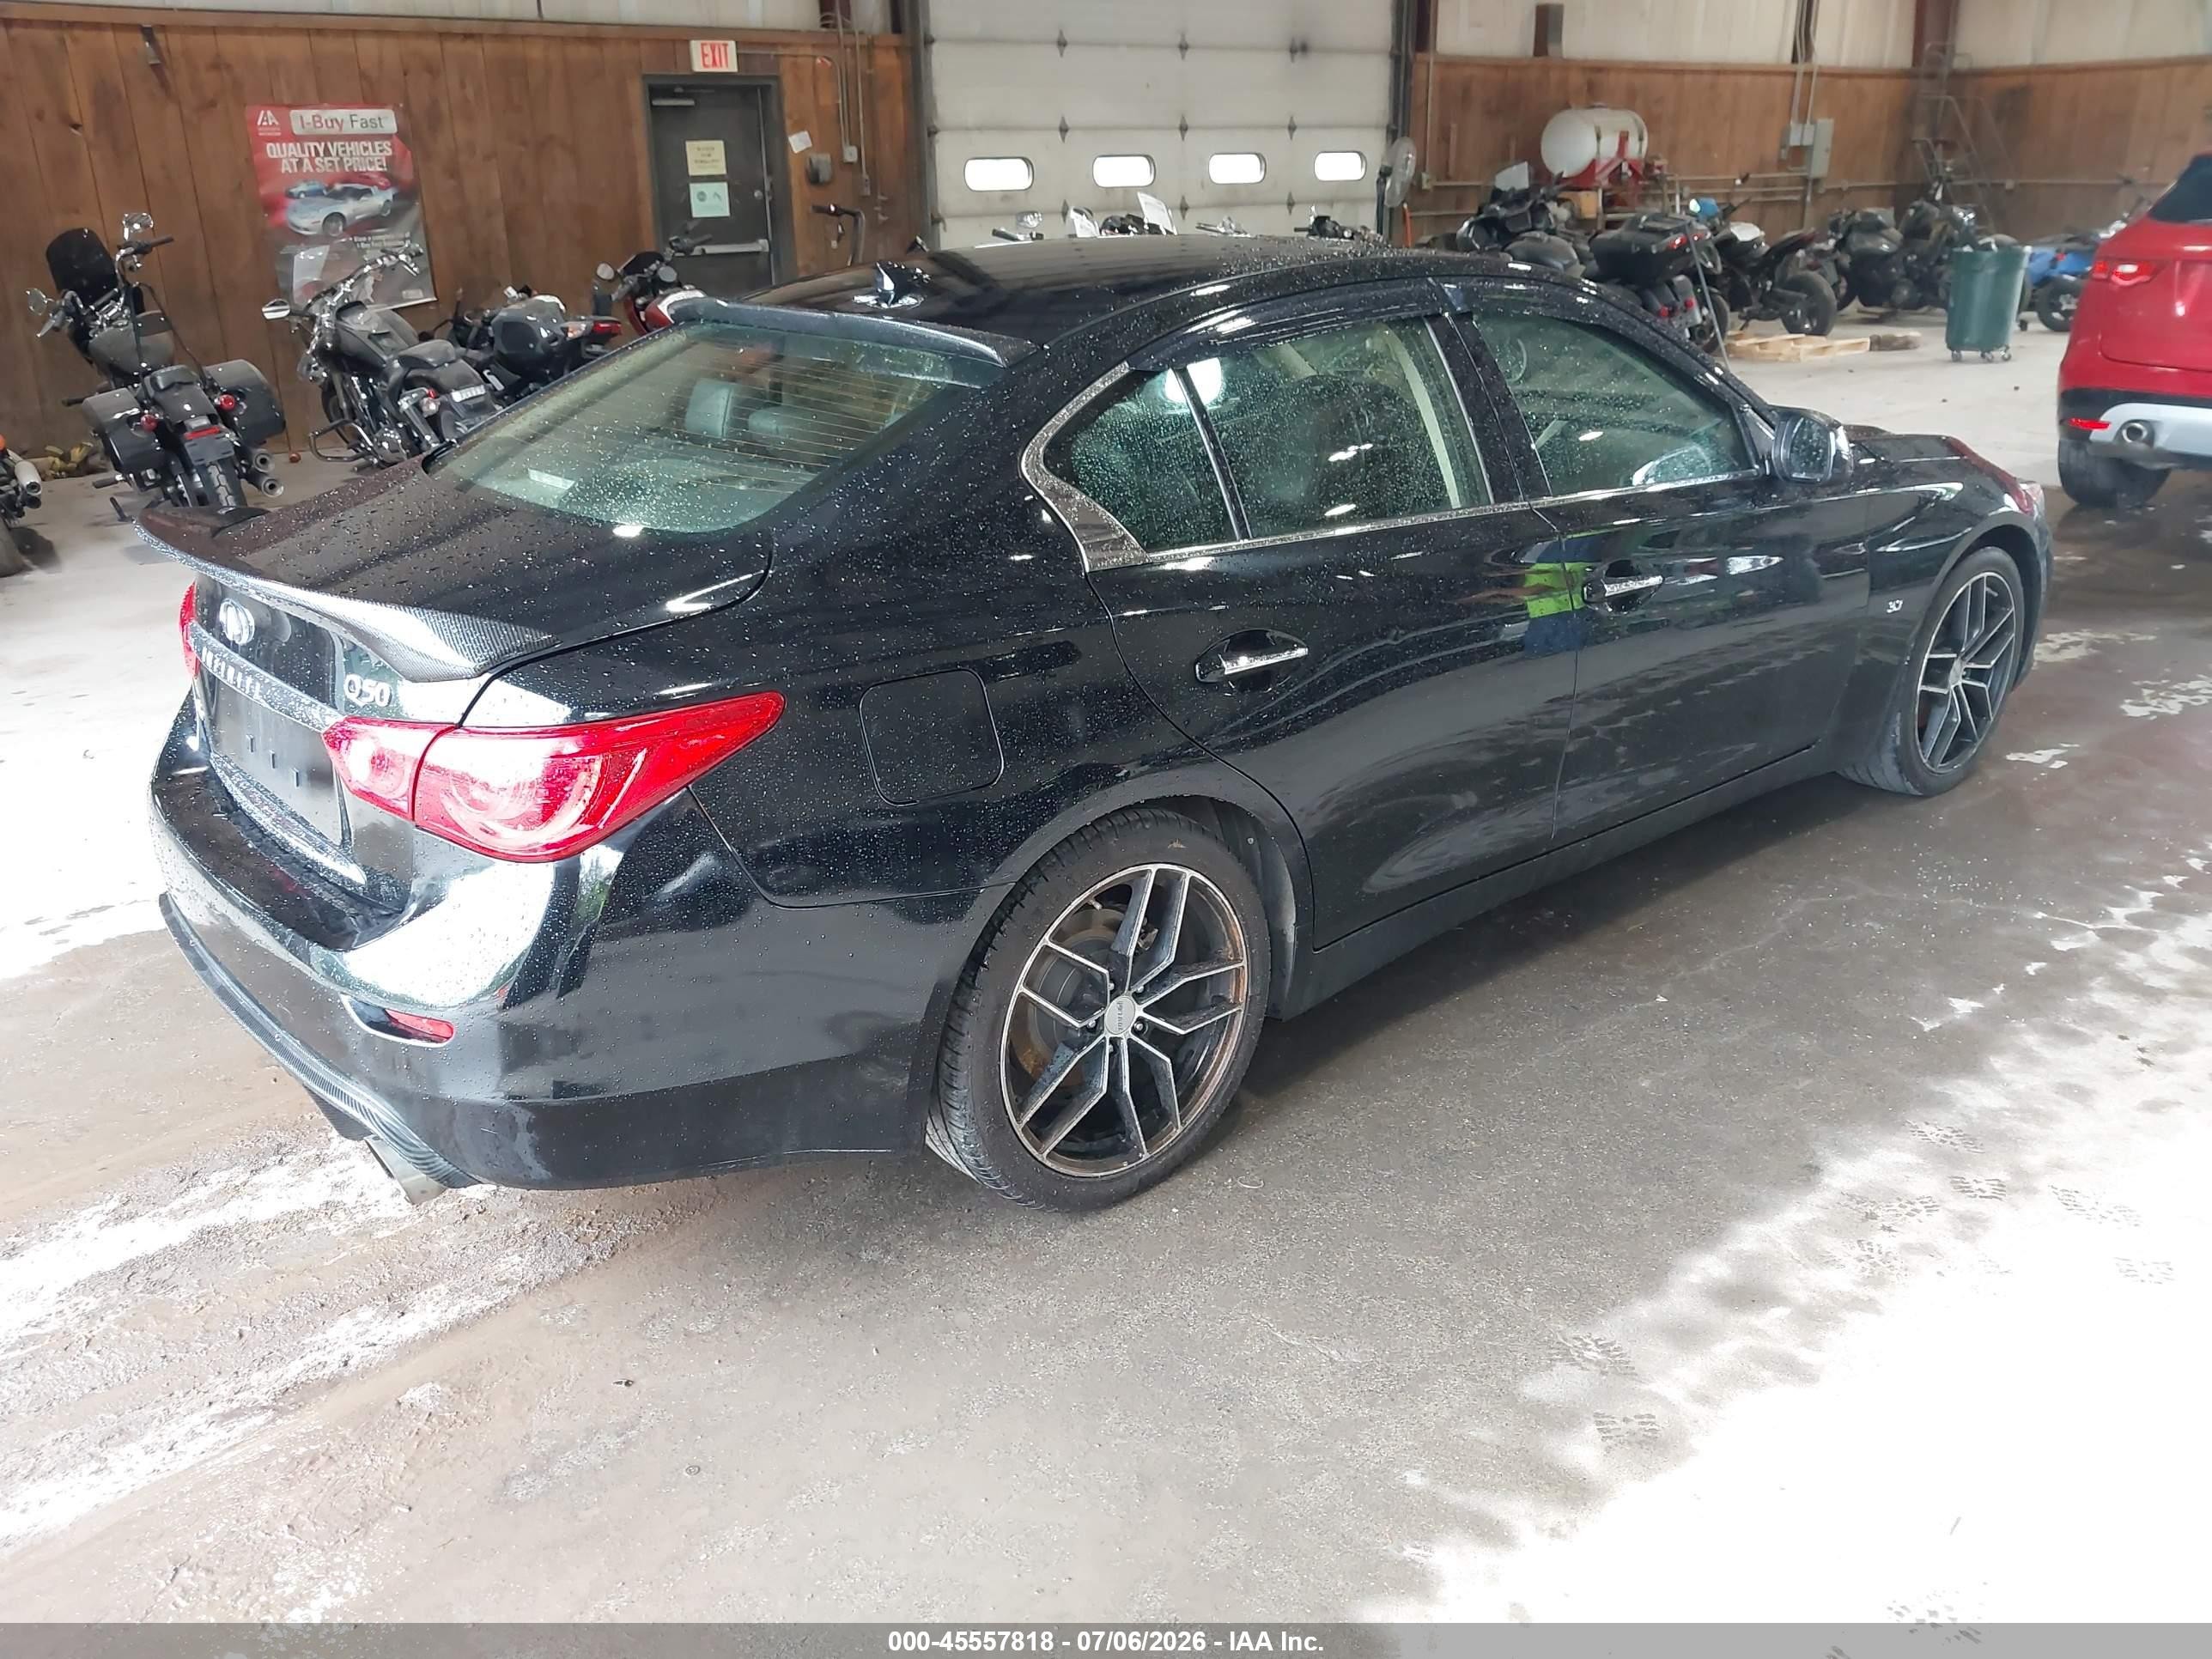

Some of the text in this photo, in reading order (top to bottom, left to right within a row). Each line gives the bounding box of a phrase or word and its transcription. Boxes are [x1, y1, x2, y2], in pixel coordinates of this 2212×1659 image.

[700, 42, 728, 69] EXIT
[300, 113, 385, 131] I-Buy Fast
[266, 140, 392, 158] QUALITY VEHICLES
[281, 156, 387, 173] AT A SET PRICE!
[343, 673, 392, 708] Q50
